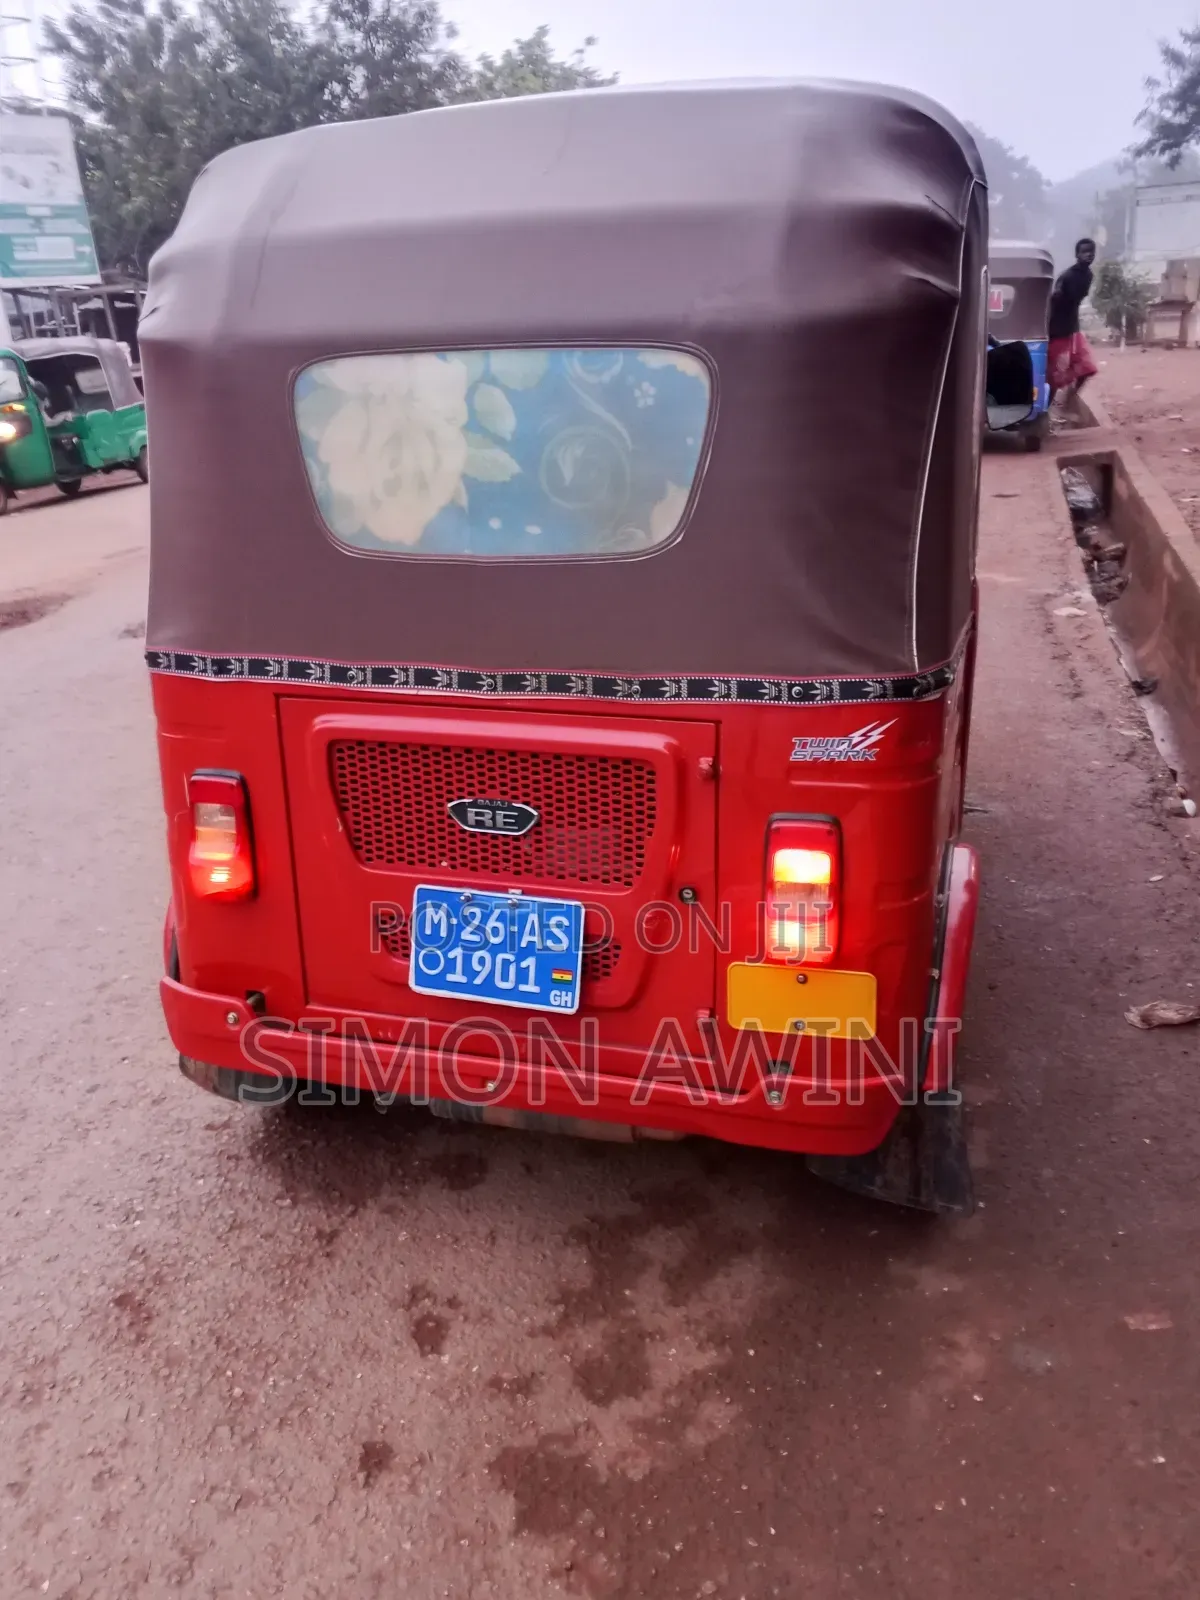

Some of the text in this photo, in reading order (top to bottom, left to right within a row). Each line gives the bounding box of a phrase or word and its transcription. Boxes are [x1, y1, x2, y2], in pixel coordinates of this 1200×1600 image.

[791, 736, 855, 750] TWIN
[789, 748, 881, 762] SPARK
[477, 799, 509, 808] BAJAJ
[467, 808, 519, 830] RE
[550, 989, 573, 1008] GH
